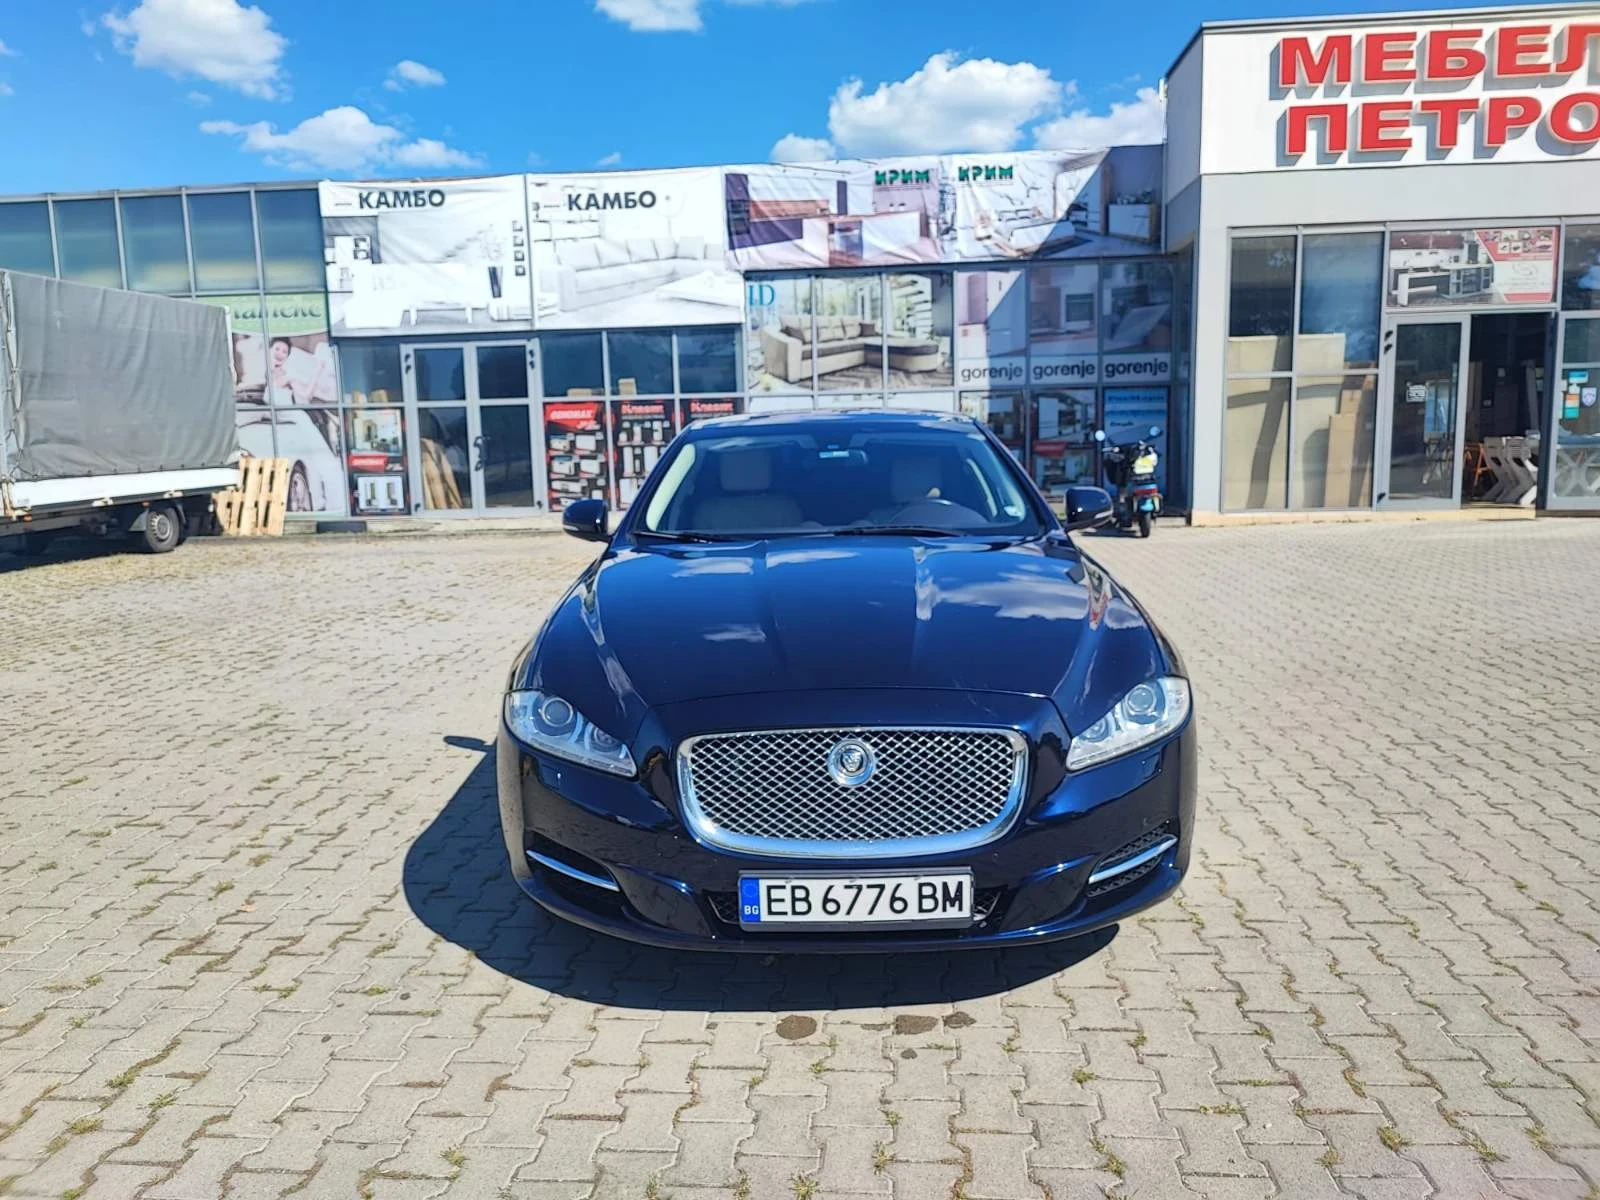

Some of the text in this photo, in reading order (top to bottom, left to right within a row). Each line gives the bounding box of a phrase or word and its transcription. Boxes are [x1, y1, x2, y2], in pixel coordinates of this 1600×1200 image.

[1279, 24, 1600, 86] МЕБЕЛ
[1286, 92, 1600, 154] ПЕТРО
[358, 189, 446, 209] КАМБО
[567, 190, 657, 211] КАМБО
[960, 362, 1023, 382] gorenje
[1032, 359, 1096, 380] gorenje
[1104, 357, 1169, 379] gorenje
[765, 880, 964, 916] EB 6776 BM
[743, 904, 760, 915] BG
